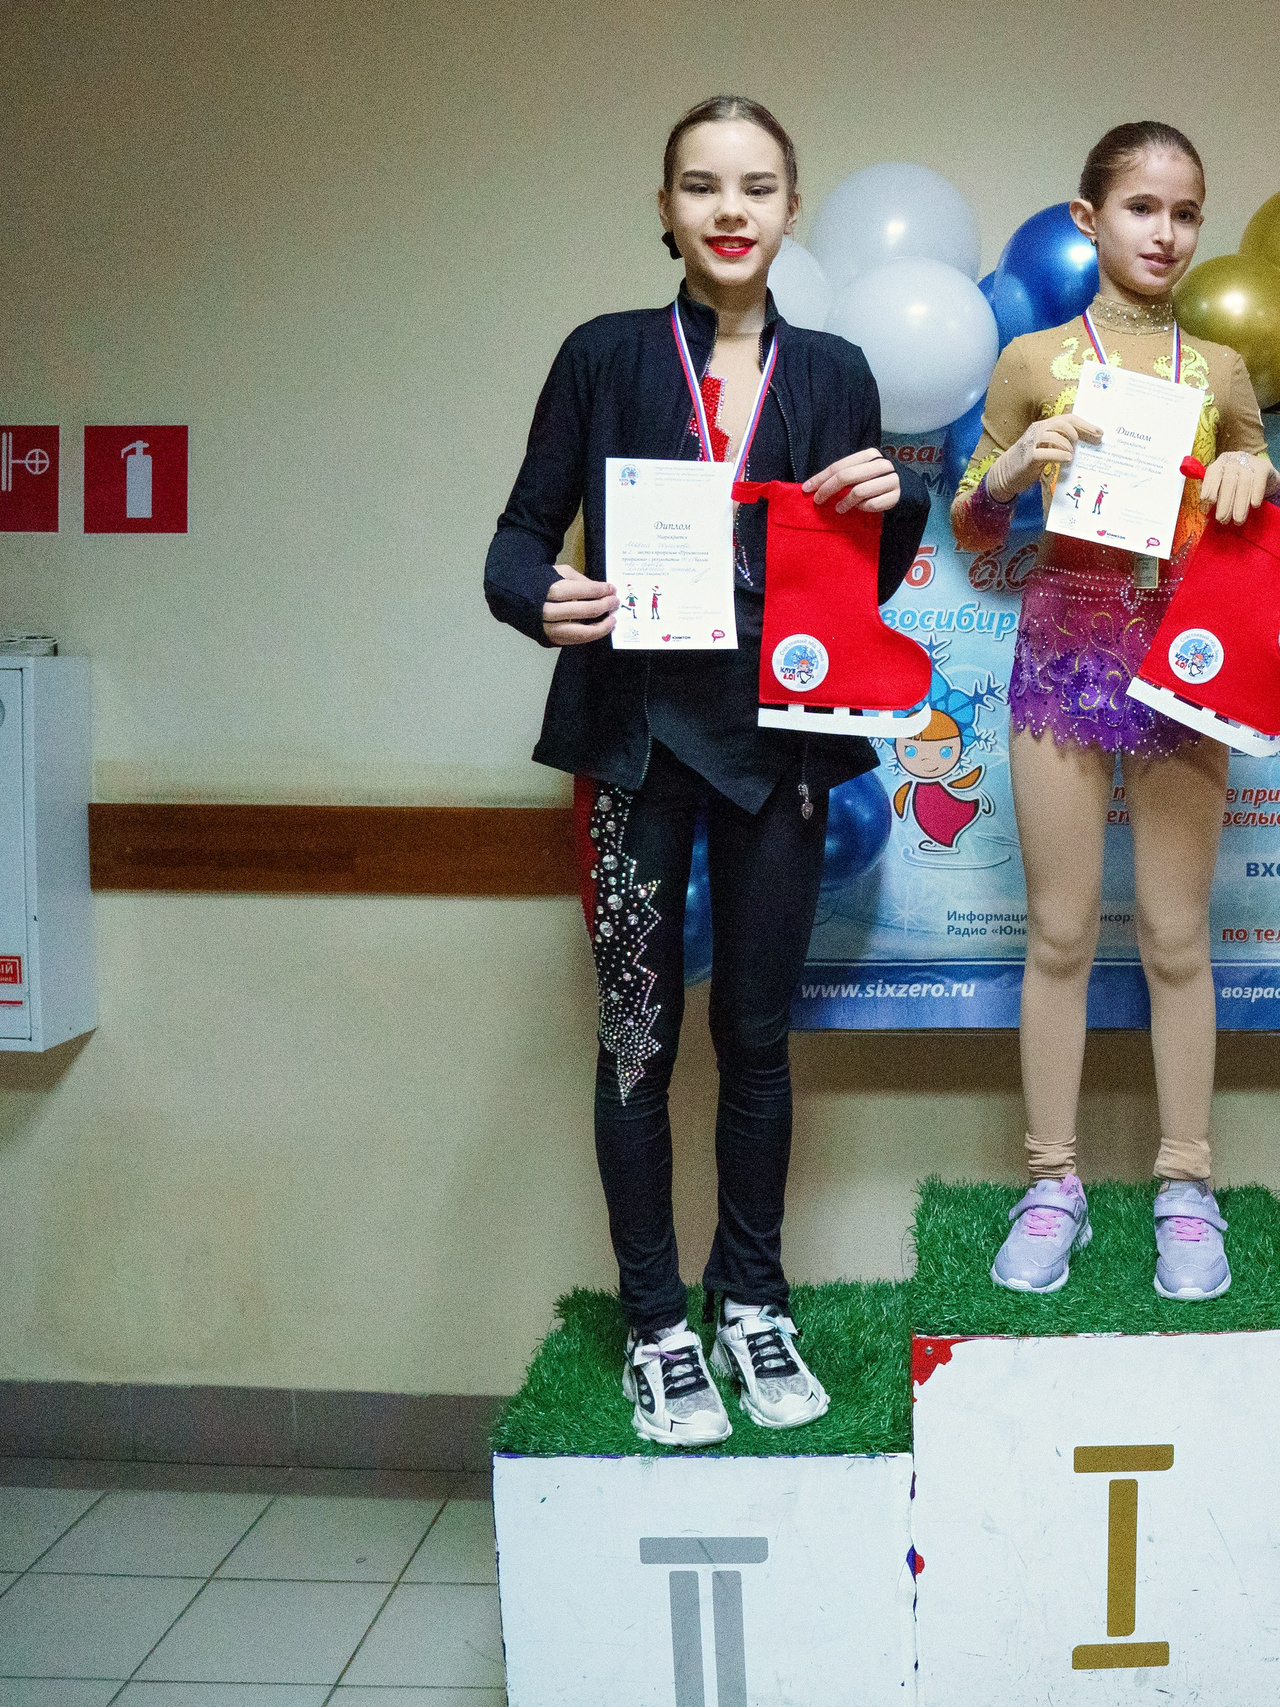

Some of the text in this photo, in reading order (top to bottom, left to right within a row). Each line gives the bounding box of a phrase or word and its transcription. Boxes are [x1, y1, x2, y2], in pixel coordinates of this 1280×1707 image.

[1116, 426, 1152, 442] Диплом
[654, 521, 691, 531] Диплом
[947, 911, 1027, 924] Информаци
[947, 925, 987, 937] Радио
[1222, 928, 1247, 941] по
[802, 979, 976, 998] www.sixzero.ru
